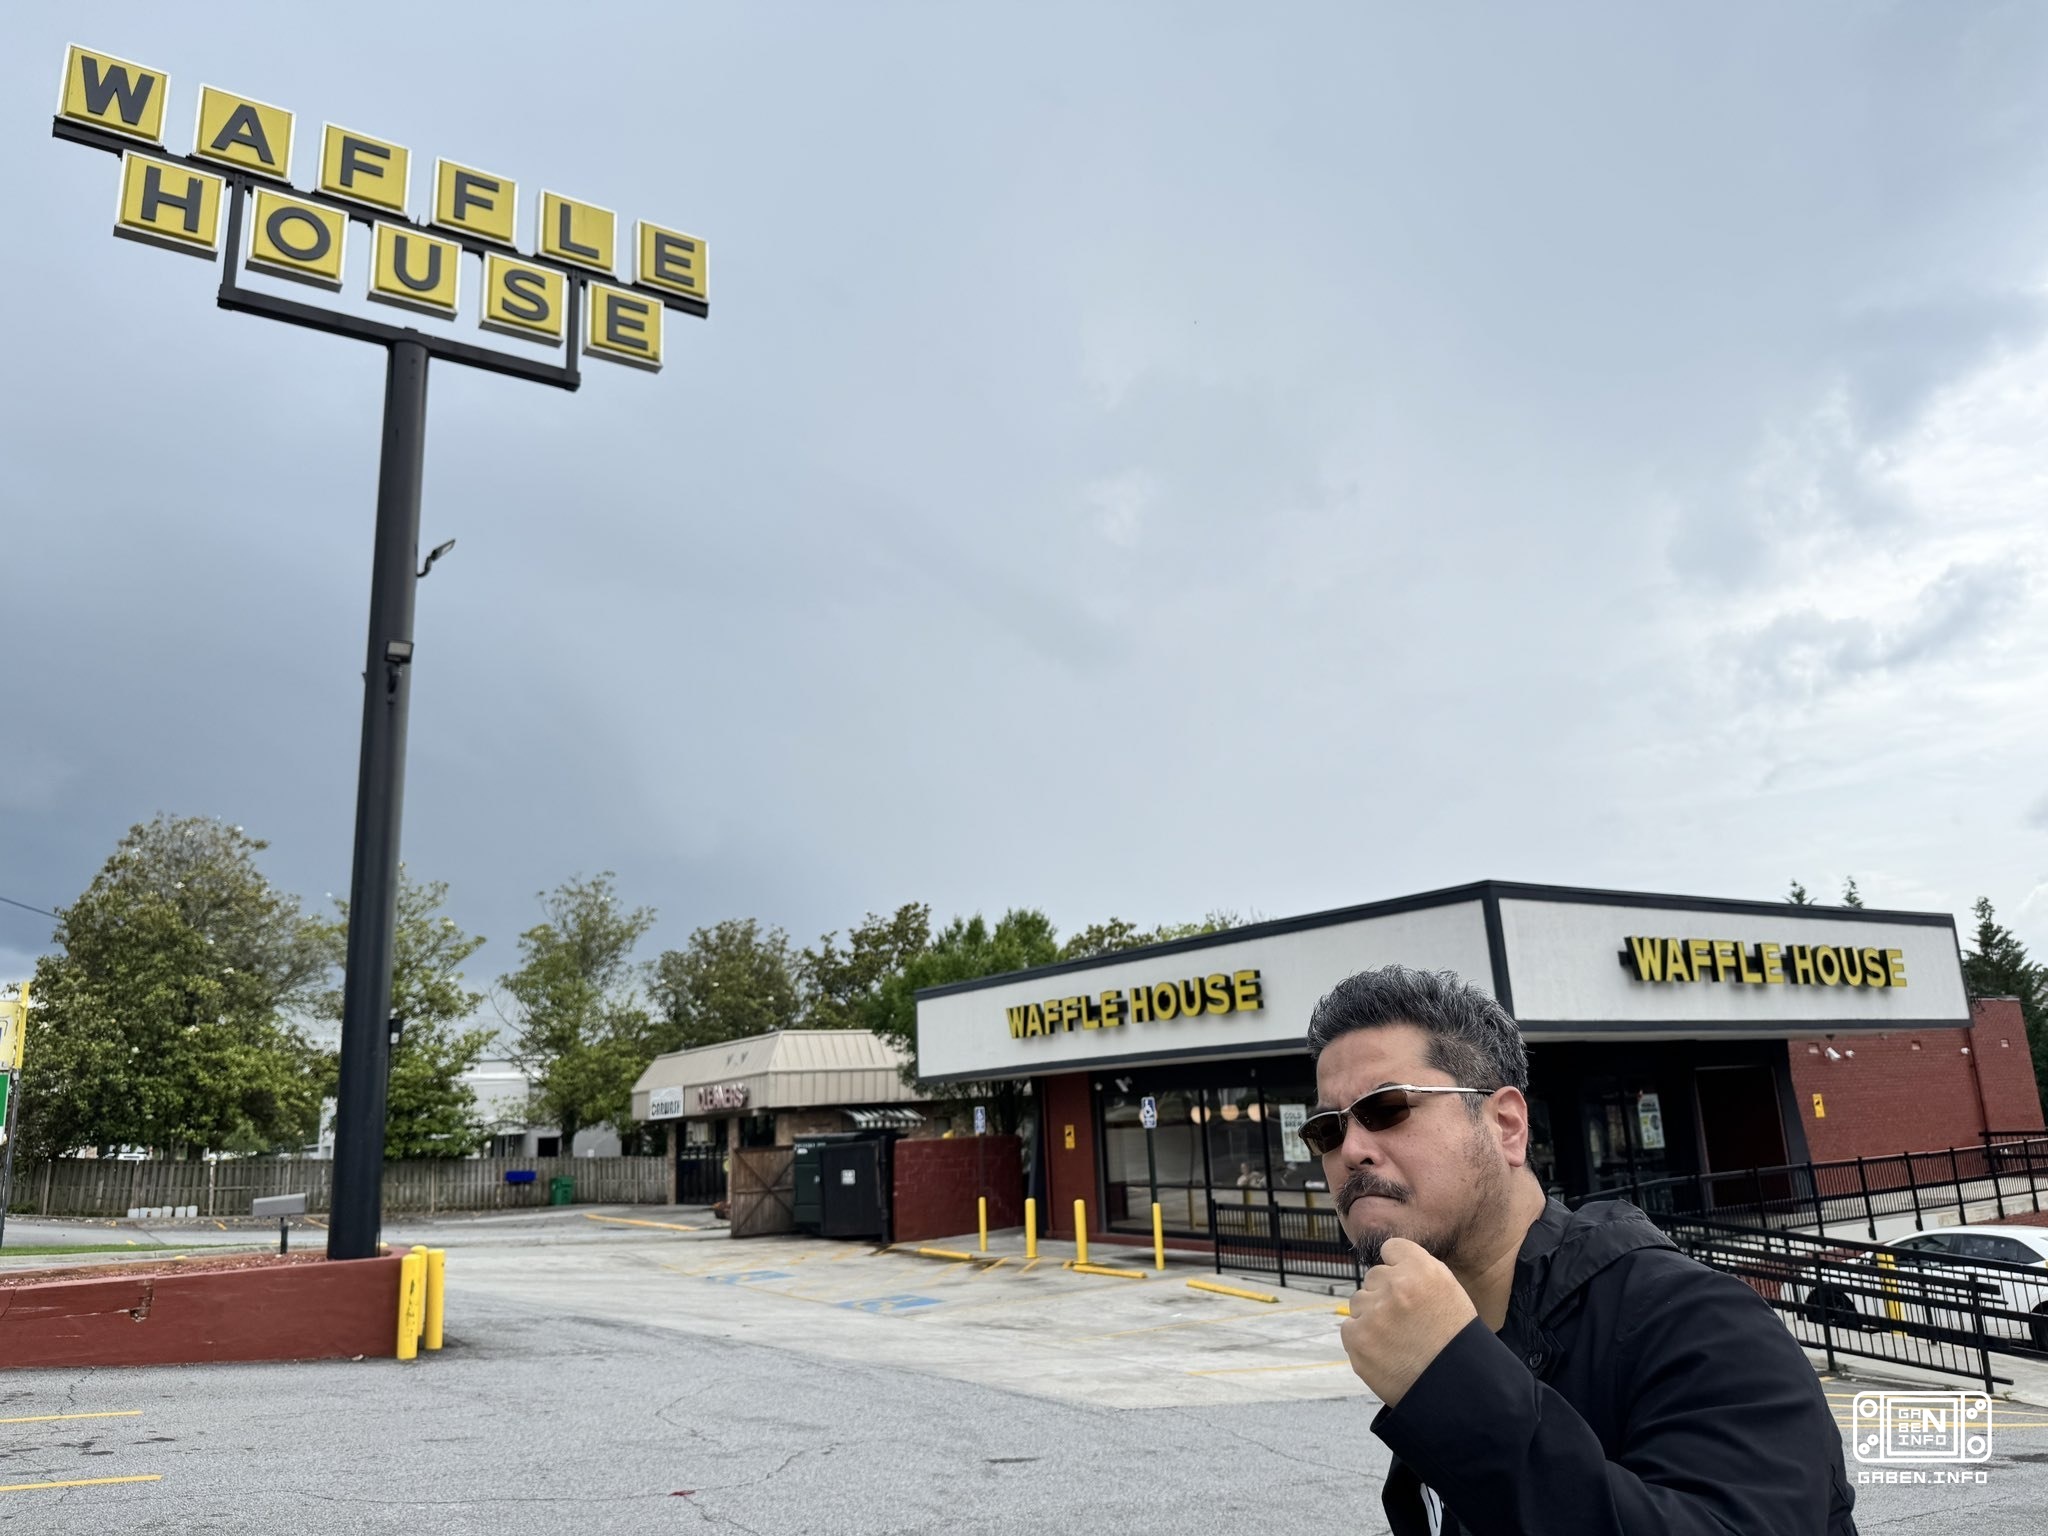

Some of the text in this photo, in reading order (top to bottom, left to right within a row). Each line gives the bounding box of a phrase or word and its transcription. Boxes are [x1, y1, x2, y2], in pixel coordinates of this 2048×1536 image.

[80, 54, 696, 288] WAFFLE
[139, 164, 650, 352] HOUSE
[1006, 970, 1263, 1039] WAFFLE HOUSE
[1628, 936, 1907, 987] WAFFLE HOUSE
